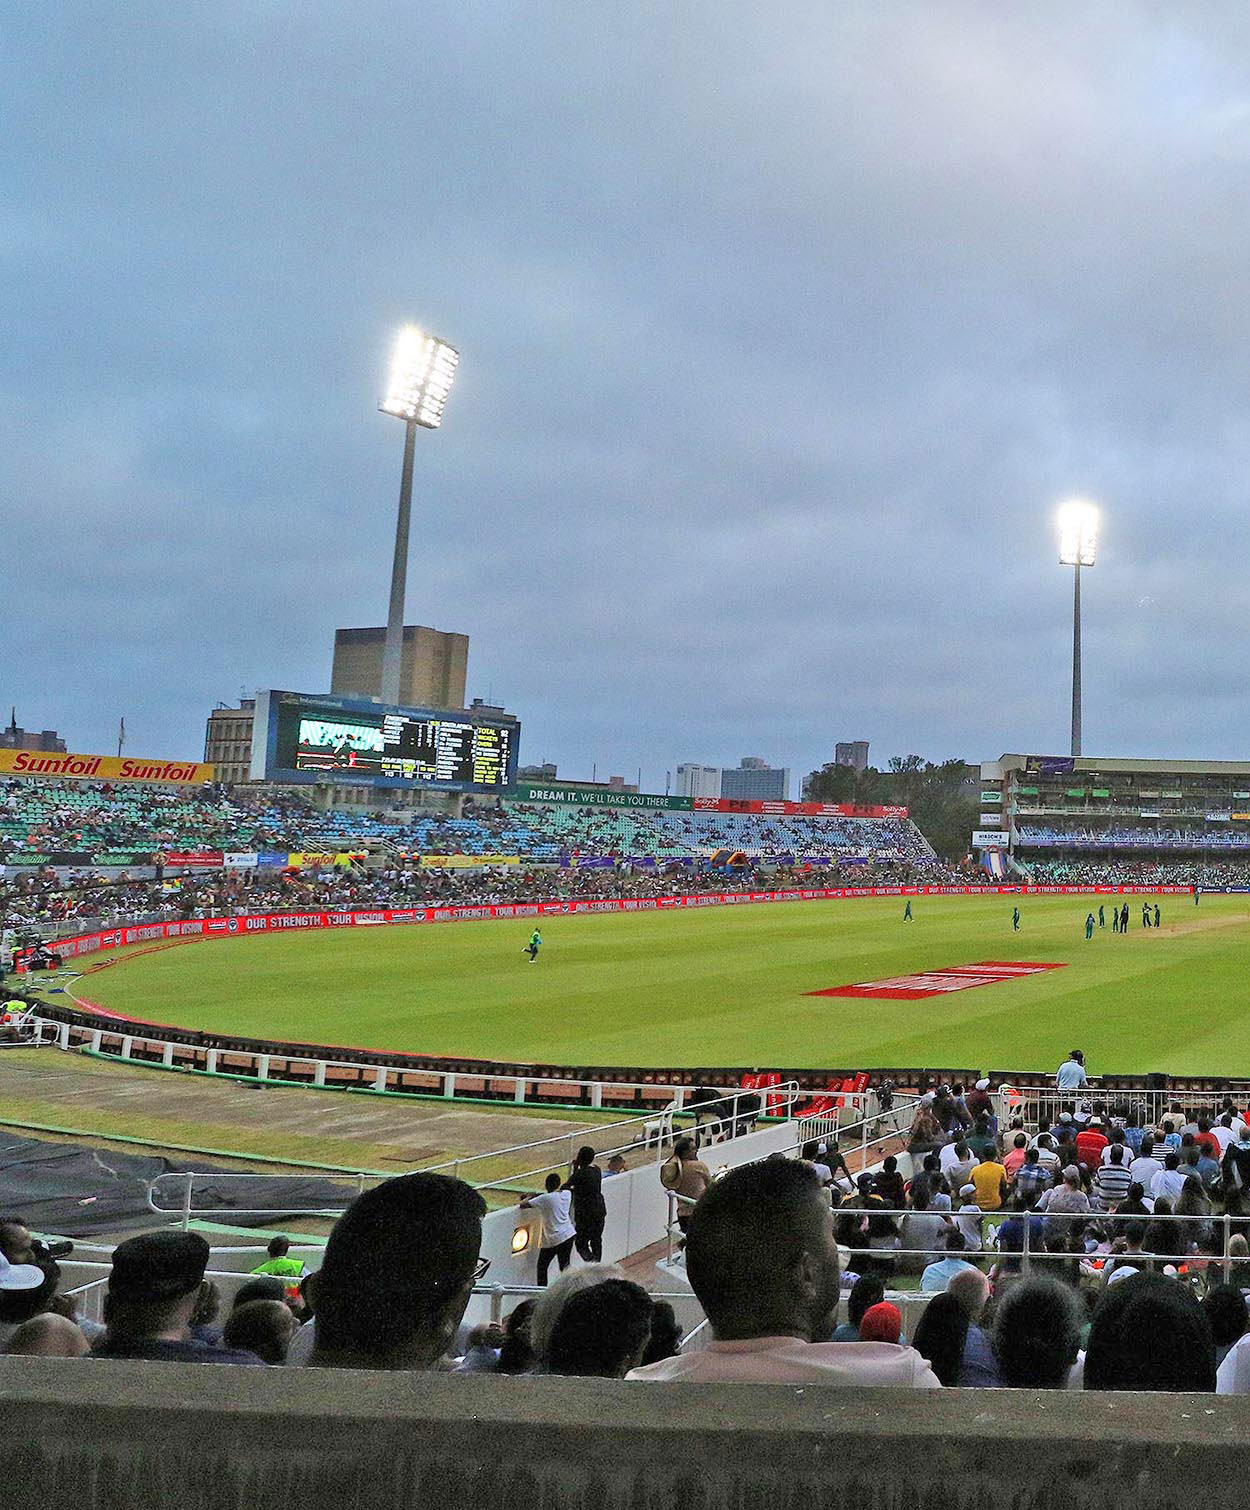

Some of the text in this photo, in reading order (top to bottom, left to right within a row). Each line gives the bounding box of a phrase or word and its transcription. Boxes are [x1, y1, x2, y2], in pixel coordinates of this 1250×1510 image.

[477, 728, 496, 736] TOTAL
[13, 752, 102, 776] Sunfoil
[119, 760, 197, 781] Sunfoil
[529, 790, 564, 801] DREAM
[567, 793, 578, 801] IT.
[581, 793, 604, 803] WE'LL
[607, 795, 626, 805] TAKE
[627, 796, 644, 806] YOU
[646, 797, 672, 808] THERE.
[302, 854, 336, 865] Sunfoil
[246, 917, 266, 929] OUR
[327, 914, 352, 924] YOUR
